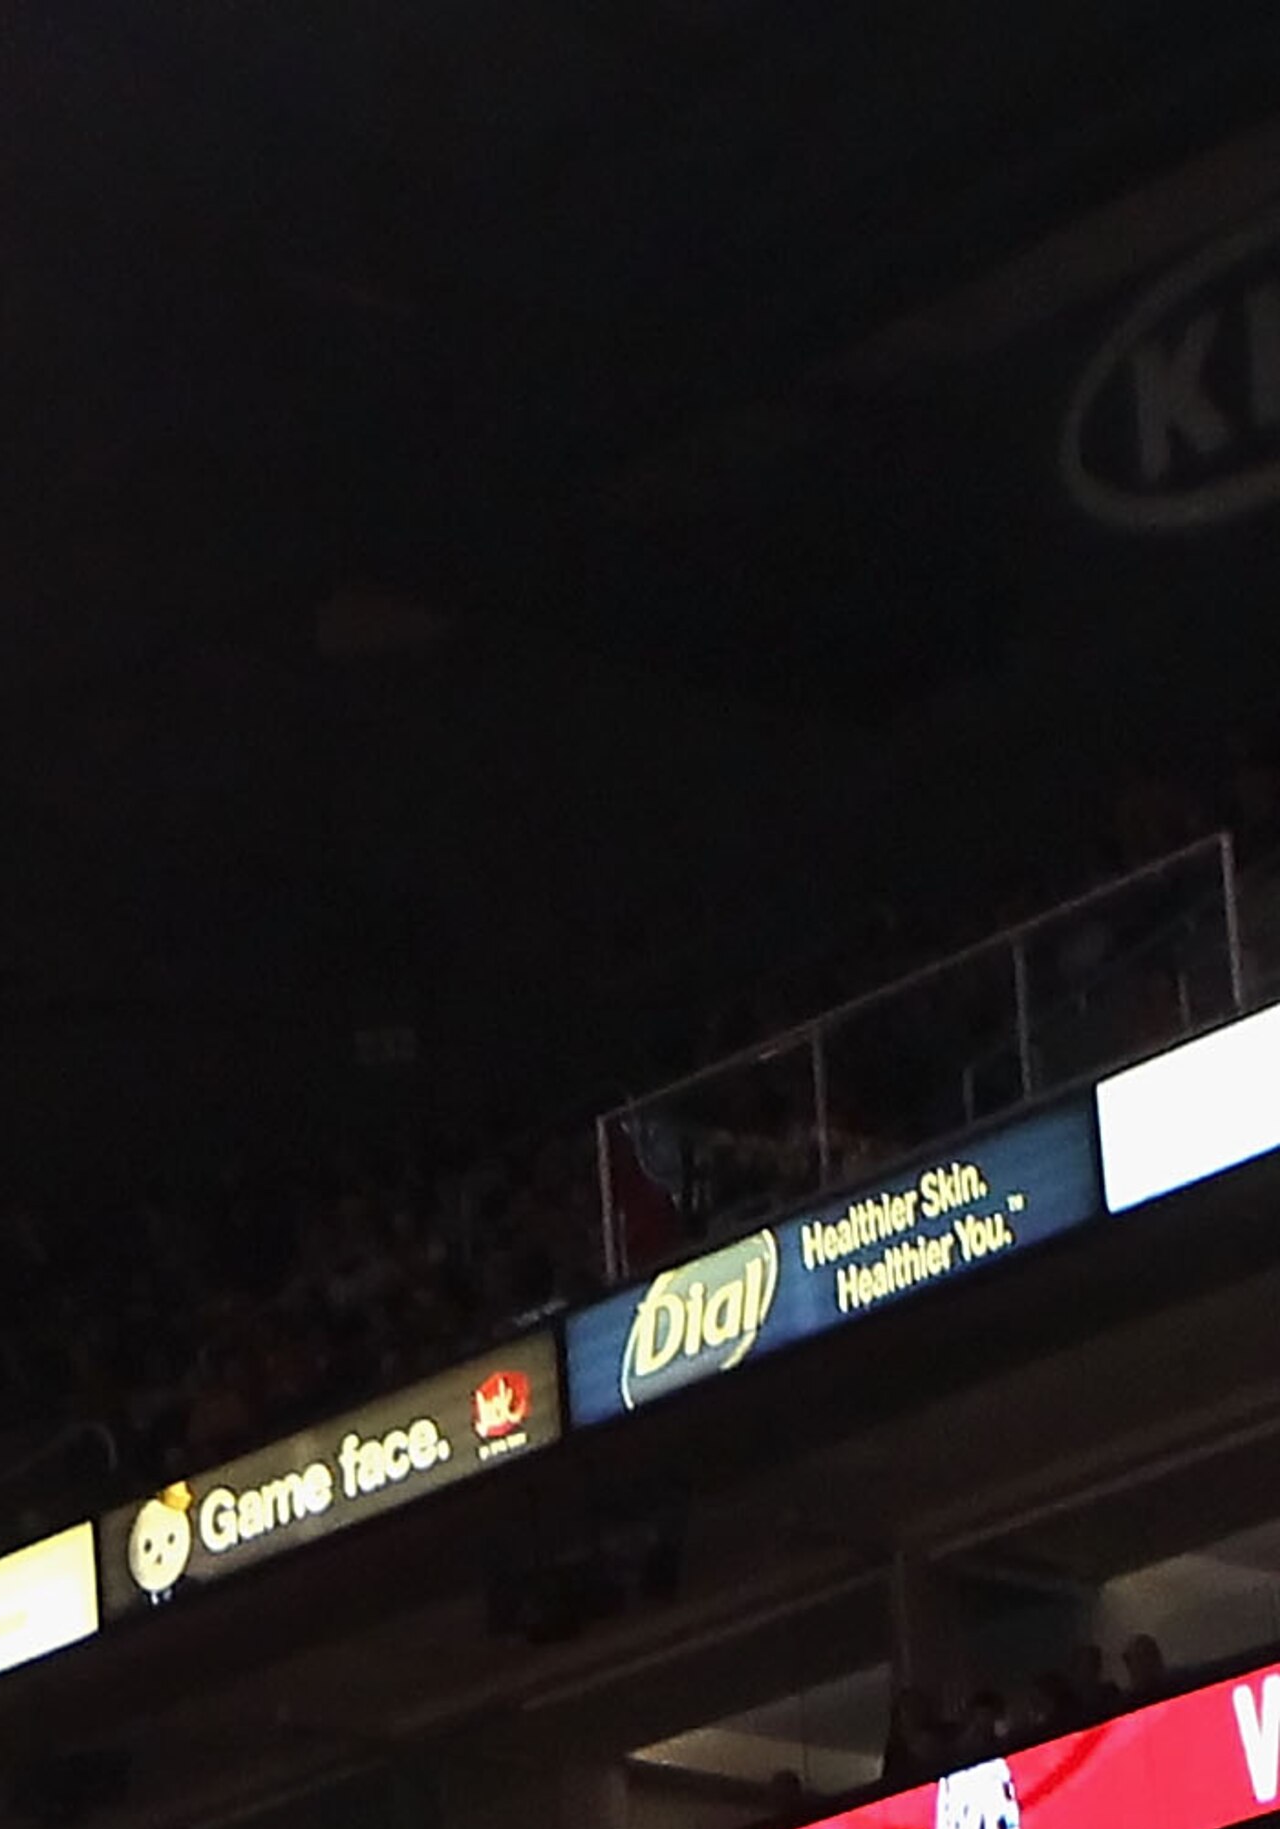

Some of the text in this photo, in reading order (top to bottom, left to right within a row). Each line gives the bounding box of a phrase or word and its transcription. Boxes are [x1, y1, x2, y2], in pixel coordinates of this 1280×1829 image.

[801, 1163, 988, 1270] Healthier Skin.
[837, 1230, 953, 1313] Healthier
[953, 1212, 1013, 1264] You.
[636, 1257, 763, 1377] Dial
[199, 1418, 451, 1553] Game face.
